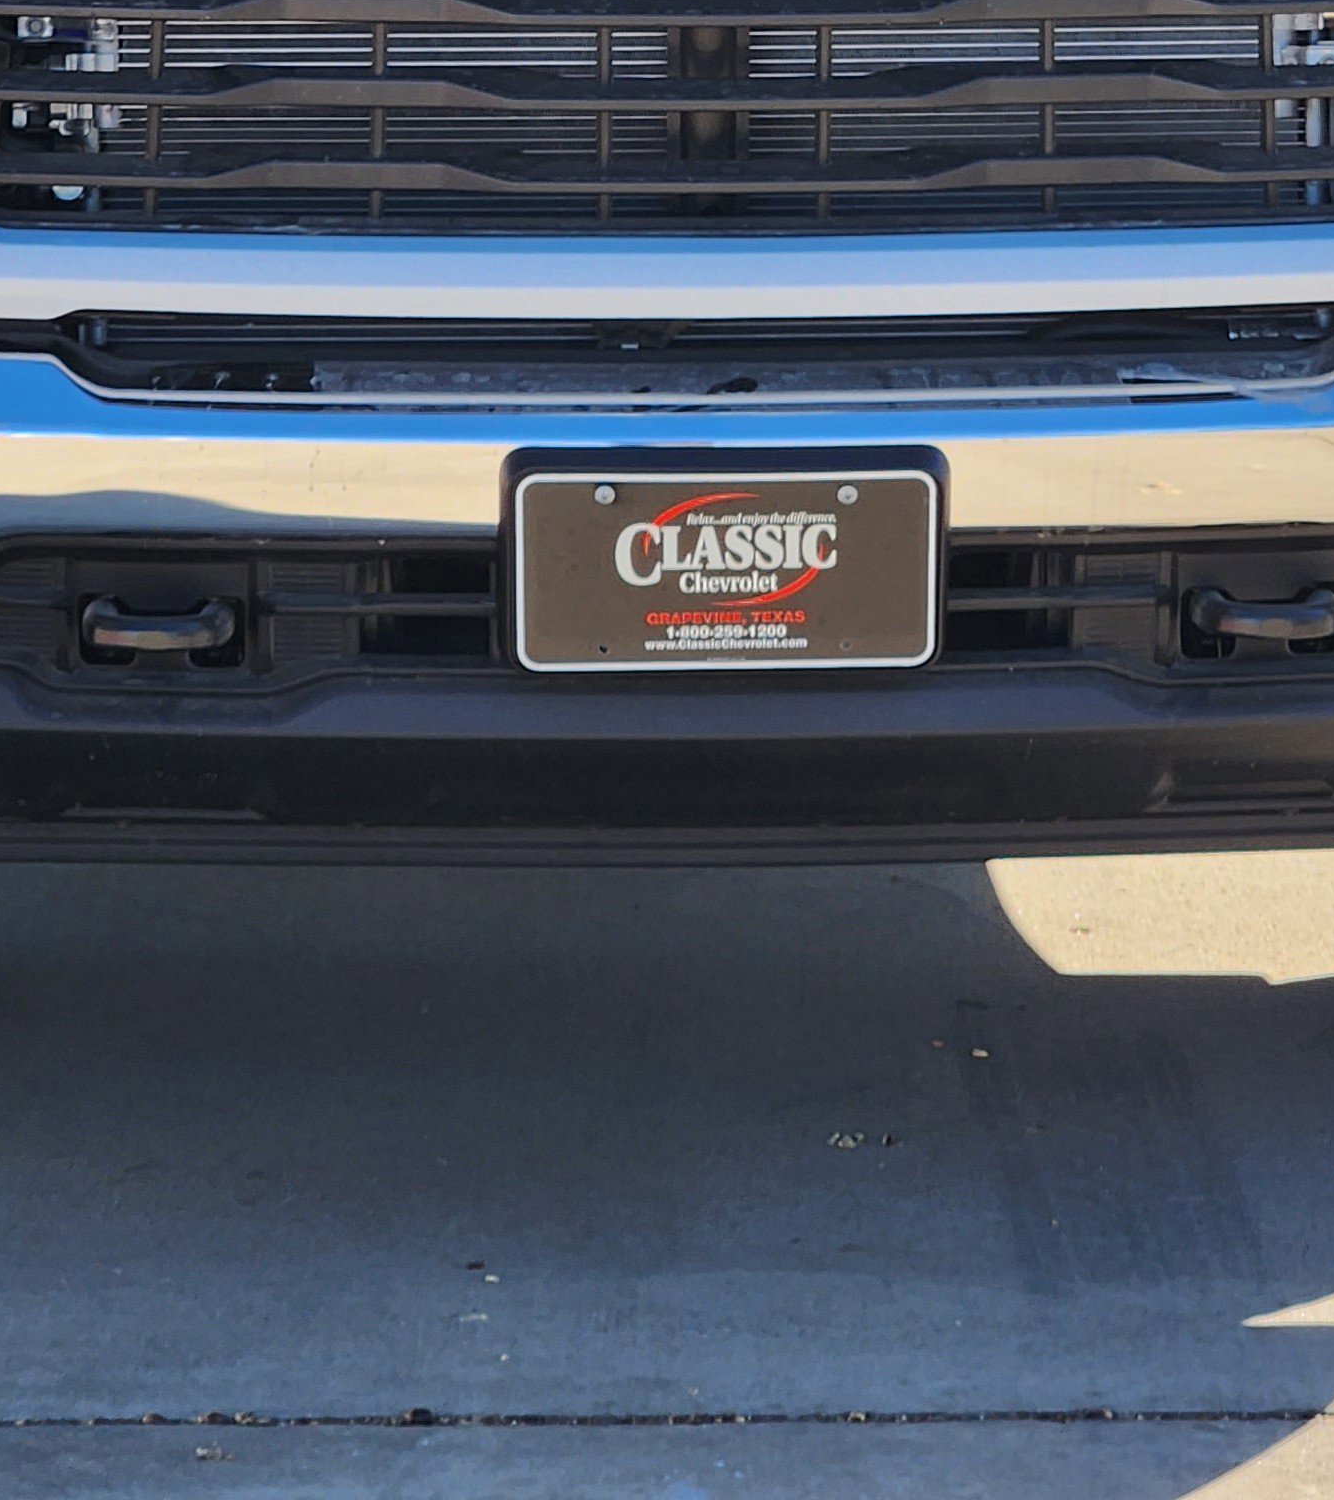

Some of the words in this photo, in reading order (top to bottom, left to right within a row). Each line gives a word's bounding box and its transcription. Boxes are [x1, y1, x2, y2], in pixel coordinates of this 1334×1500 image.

[614, 522, 838, 587] CLASSIC
[679, 570, 779, 594] Chevrolet
[646, 611, 748, 626] GRAPEVINE,
[750, 610, 806, 624] TEXAS
[644, 637, 809, 651] www.ClassicChevrolet.com
